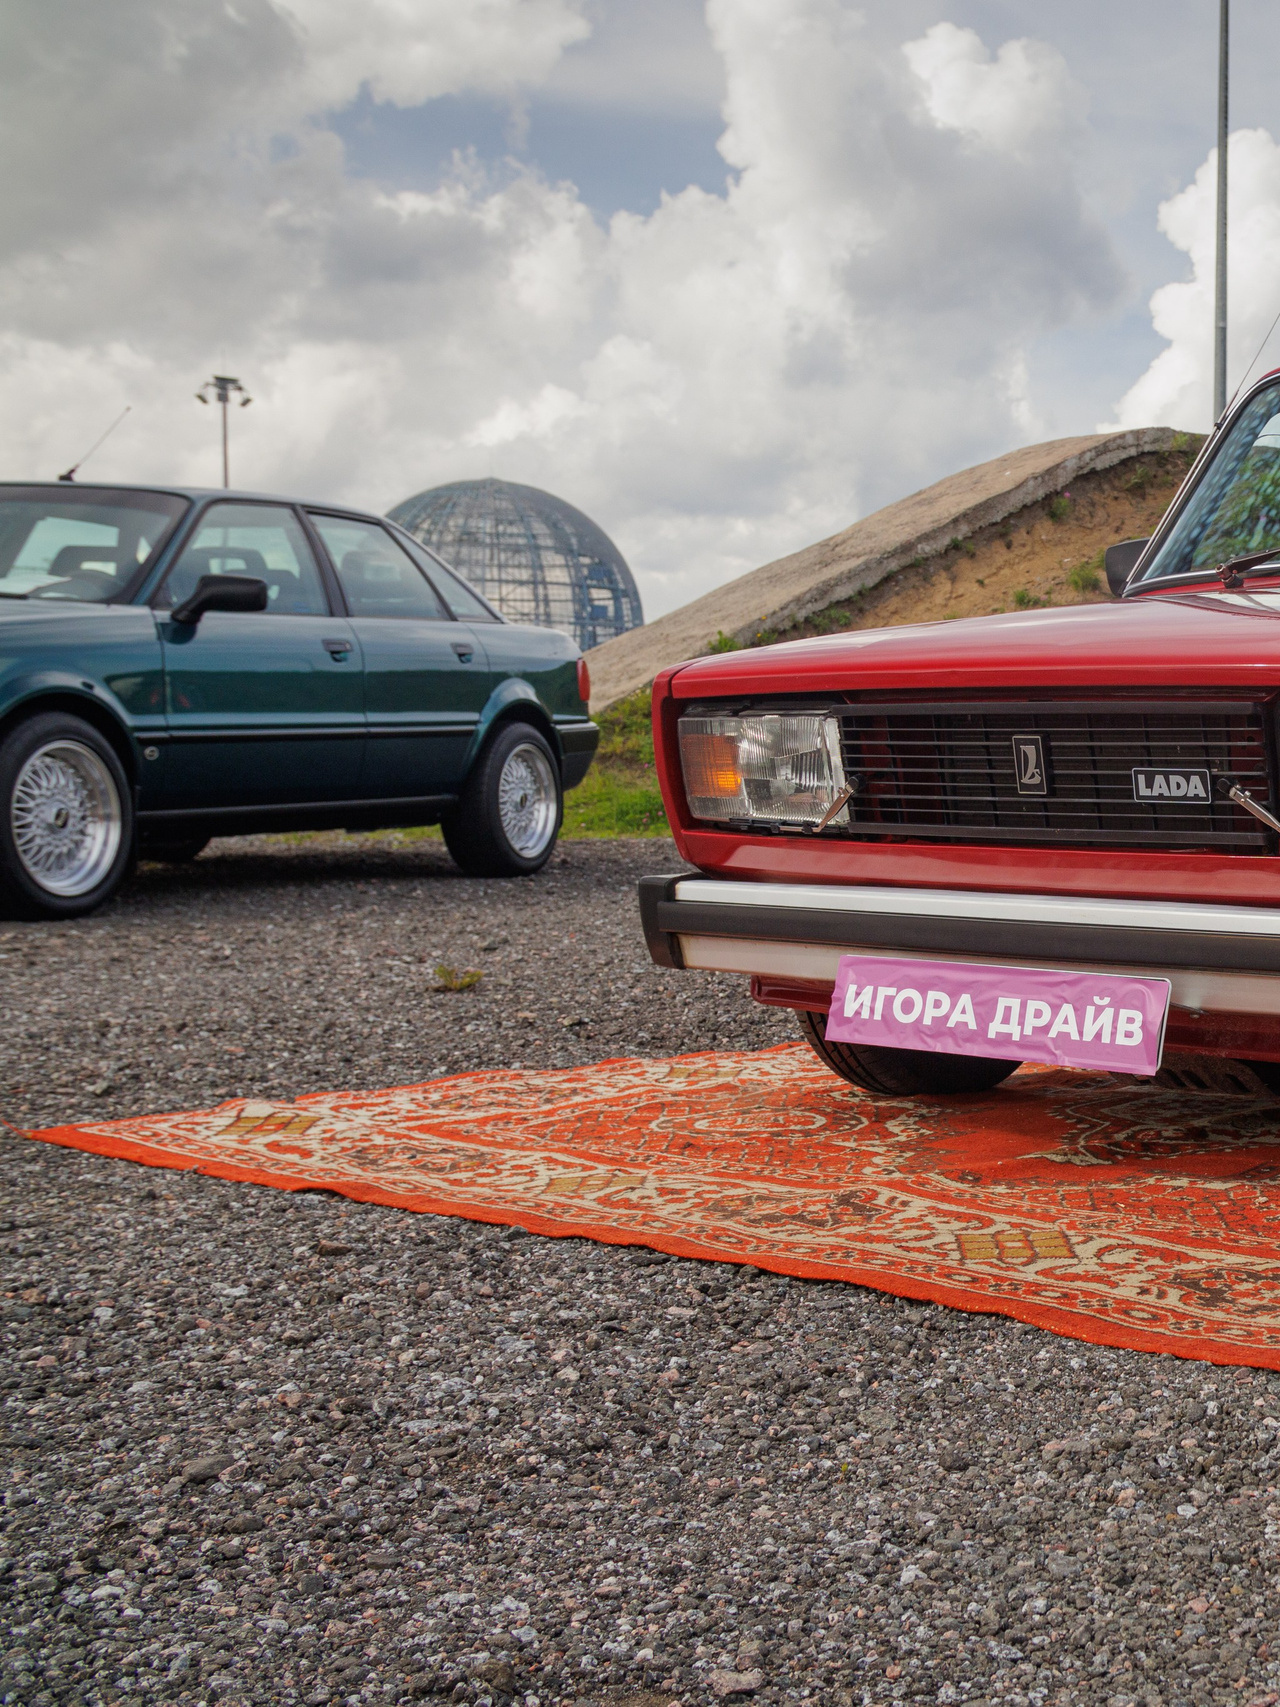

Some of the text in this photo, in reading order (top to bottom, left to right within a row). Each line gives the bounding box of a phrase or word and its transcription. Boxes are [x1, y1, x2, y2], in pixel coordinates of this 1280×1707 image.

[1137, 774, 1207, 797] LADA
[843, 984, 1144, 1047] ИГОРА ДРАЙВ
